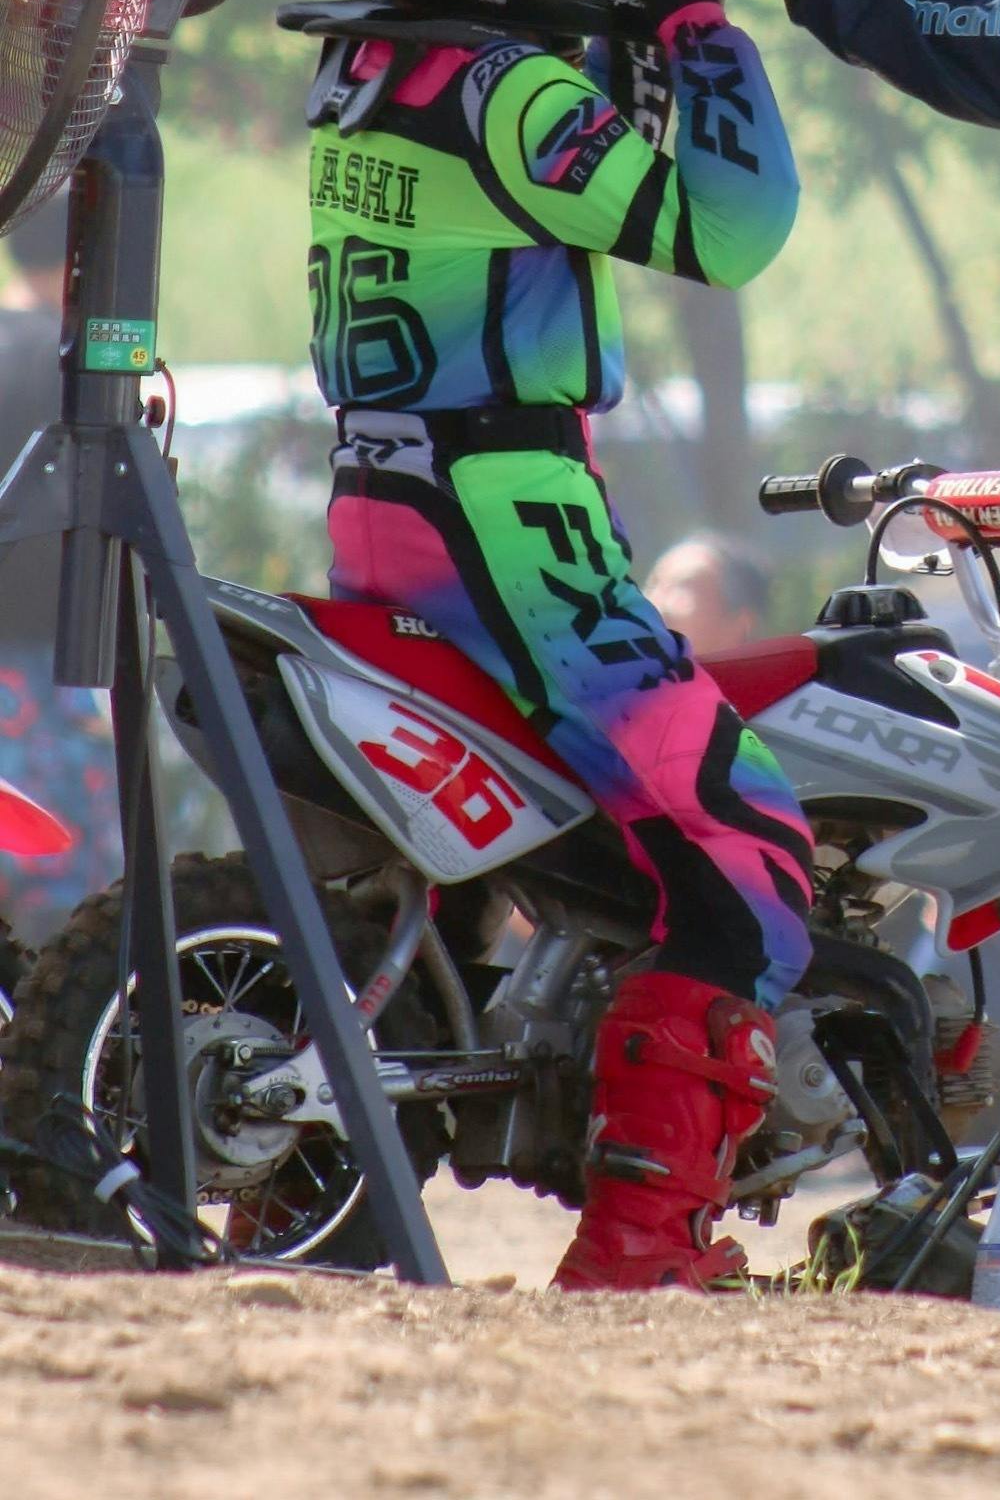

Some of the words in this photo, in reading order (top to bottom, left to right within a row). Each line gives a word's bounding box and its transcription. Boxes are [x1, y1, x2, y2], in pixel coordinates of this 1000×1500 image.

[310, 146, 420, 229] ASHI
[570, 122, 626, 185] REVO
[788, 697, 963, 774] HONDA
[357, 701, 527, 851] 36
